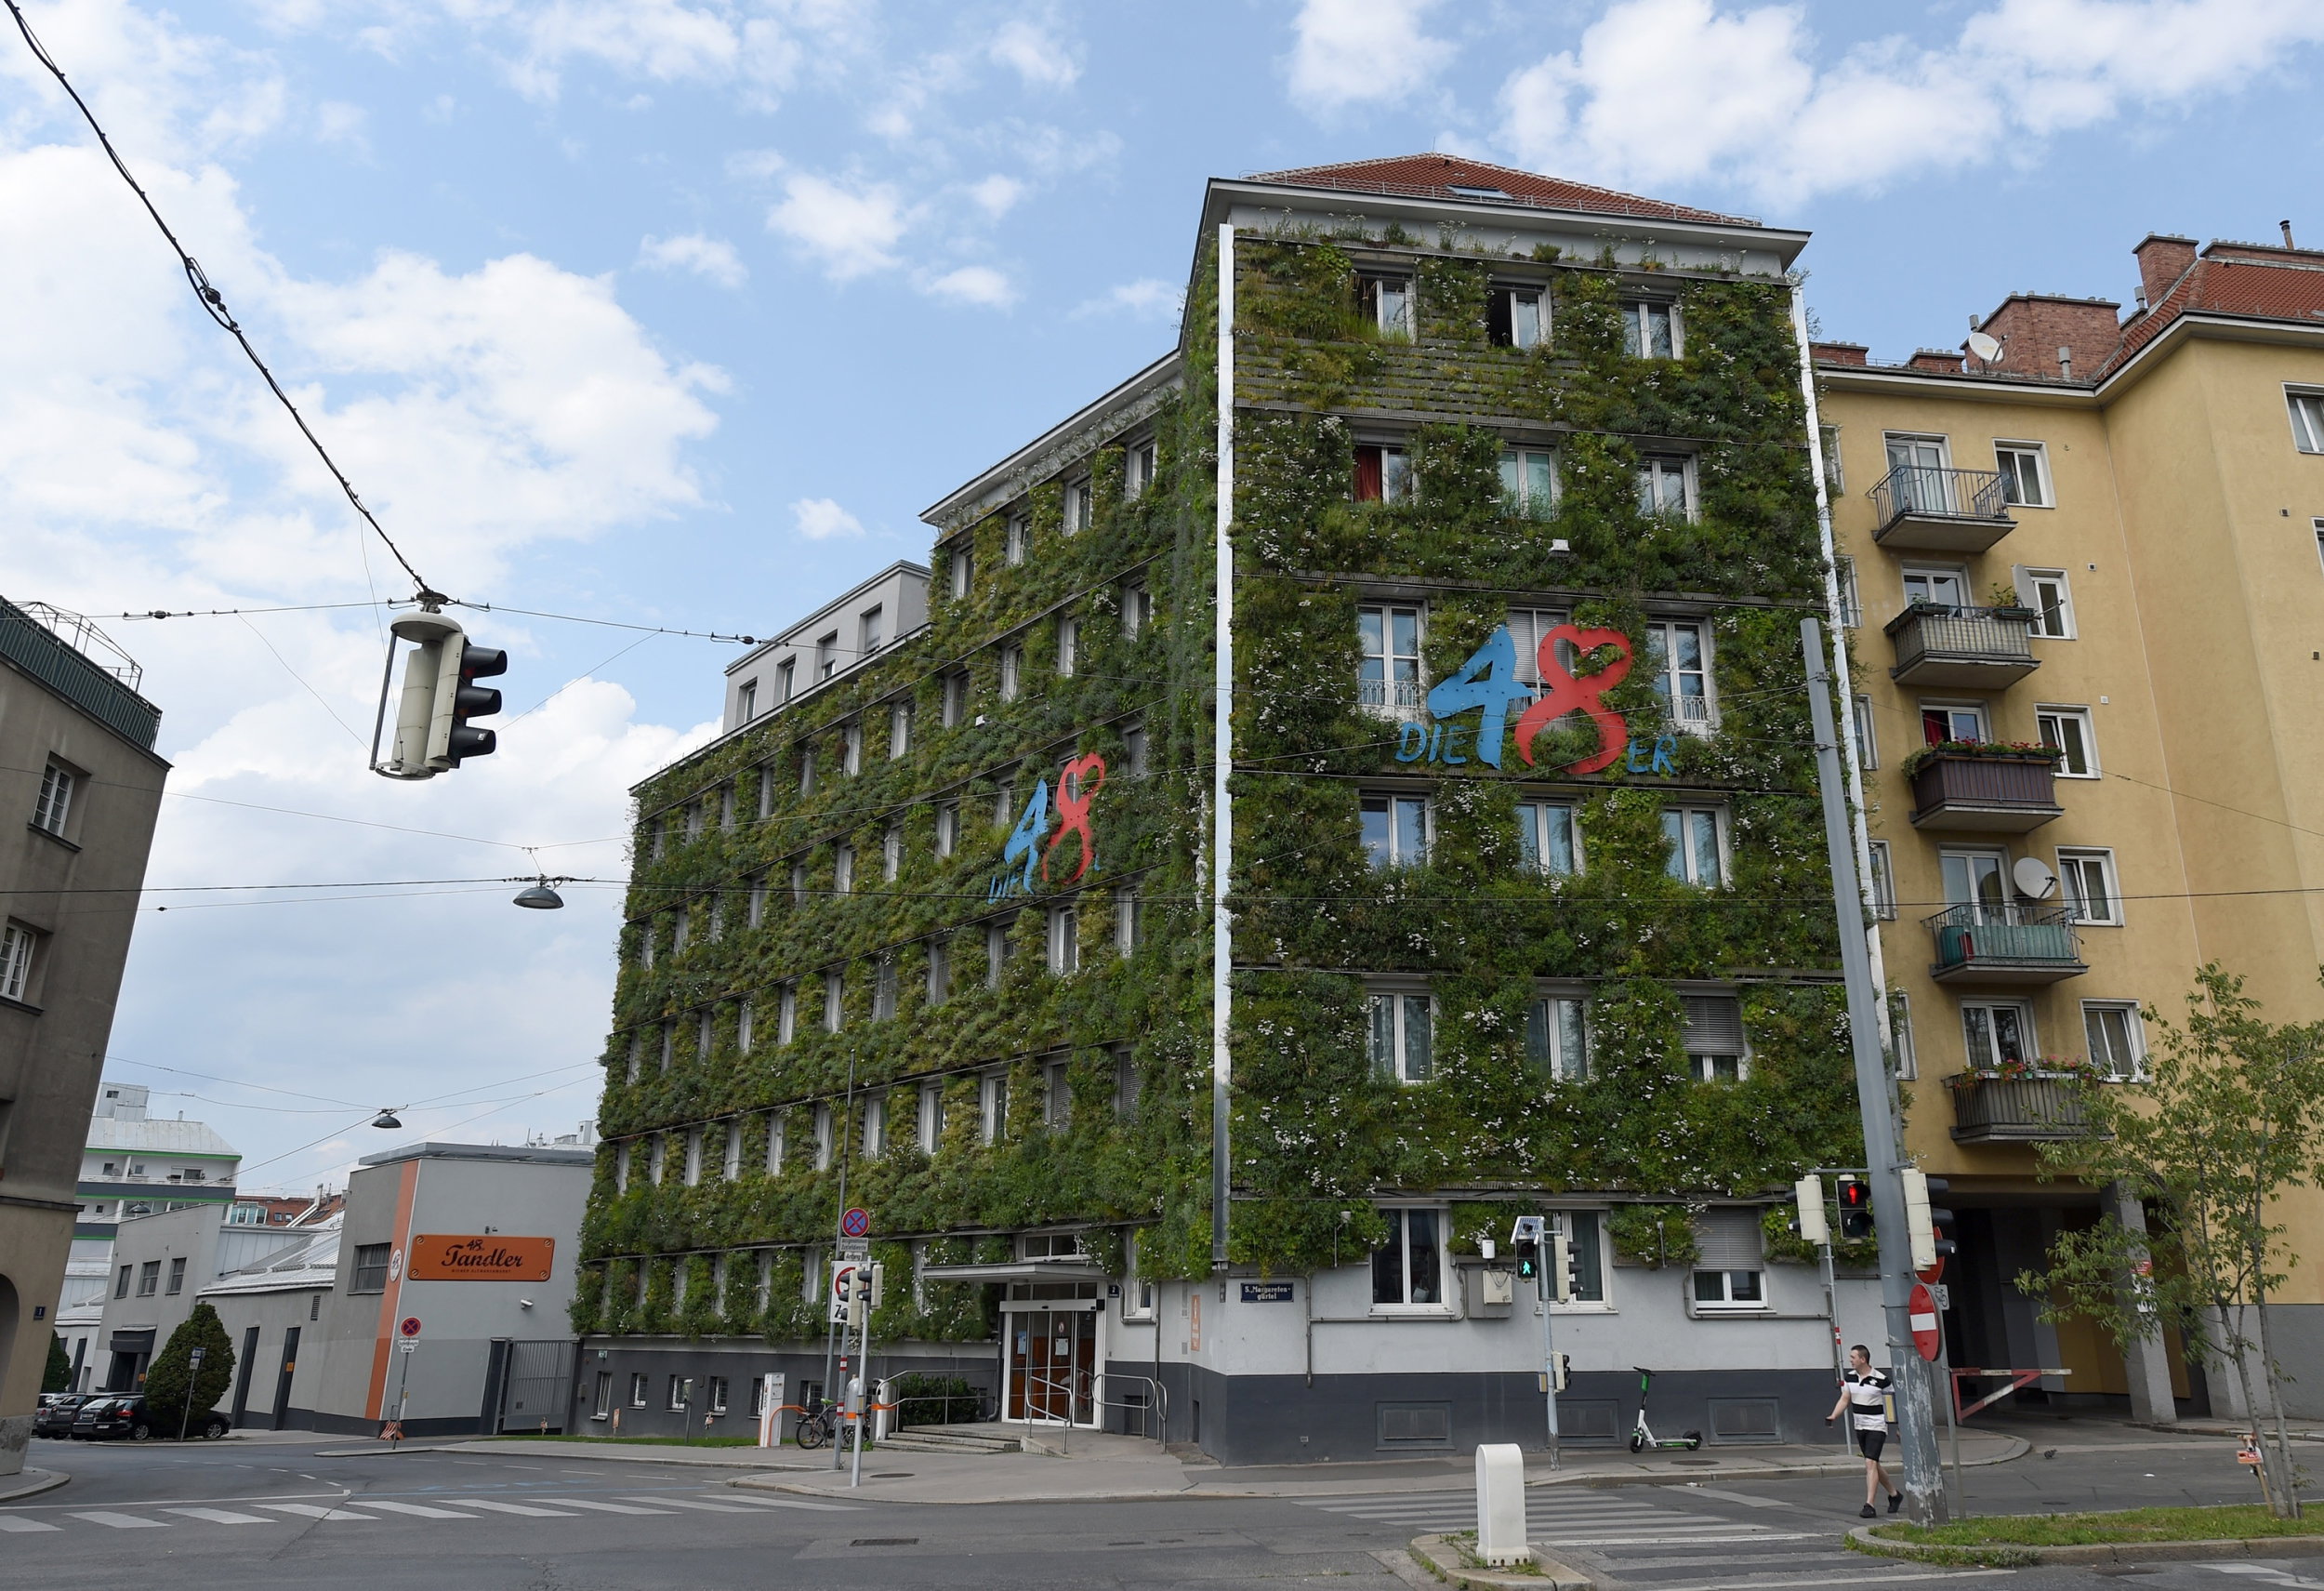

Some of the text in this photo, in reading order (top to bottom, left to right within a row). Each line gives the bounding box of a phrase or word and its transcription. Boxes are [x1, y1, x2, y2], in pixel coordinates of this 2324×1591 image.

[1395, 624, 1678, 775] DIE 48 ER
[1004, 752, 1105, 895] 48
[441, 1244, 523, 1267] Tandler
